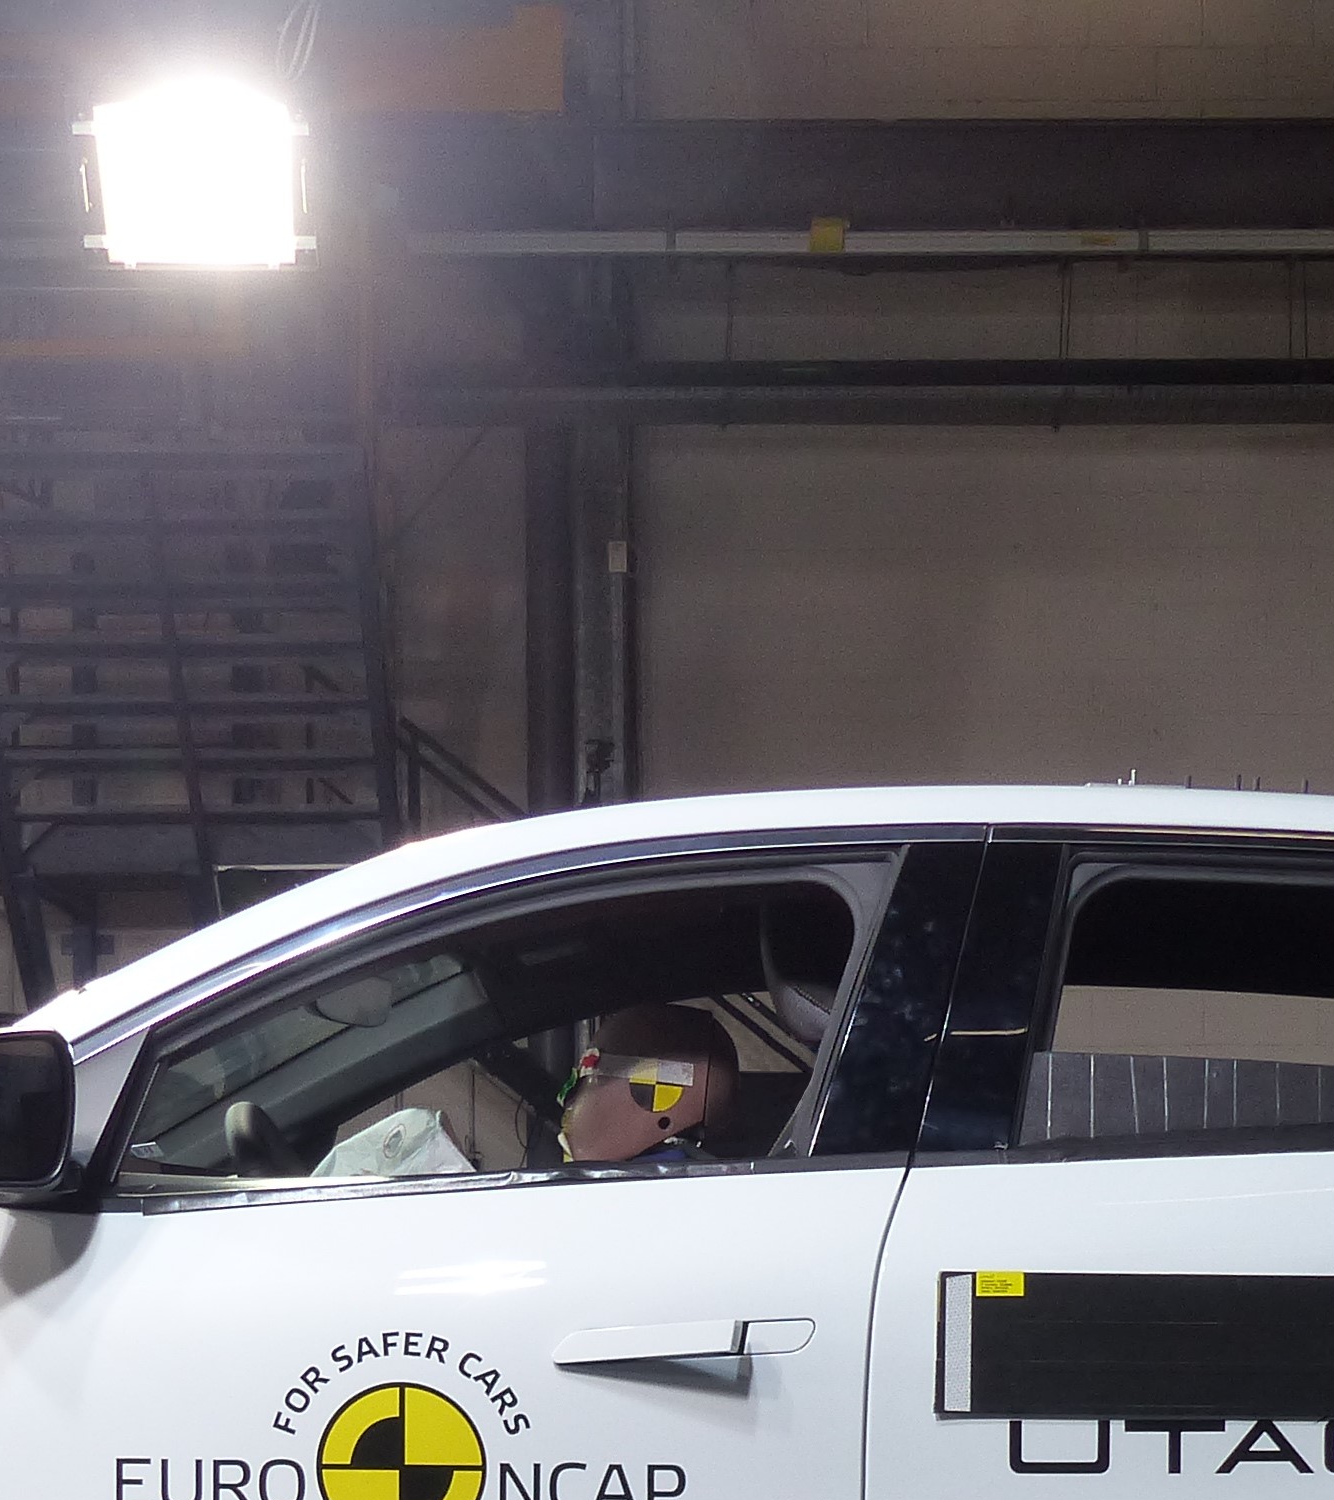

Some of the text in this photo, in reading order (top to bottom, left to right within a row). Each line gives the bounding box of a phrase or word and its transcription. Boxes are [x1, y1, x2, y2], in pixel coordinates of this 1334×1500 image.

[272, 1331, 531, 1436] FOR SAFER CARS
